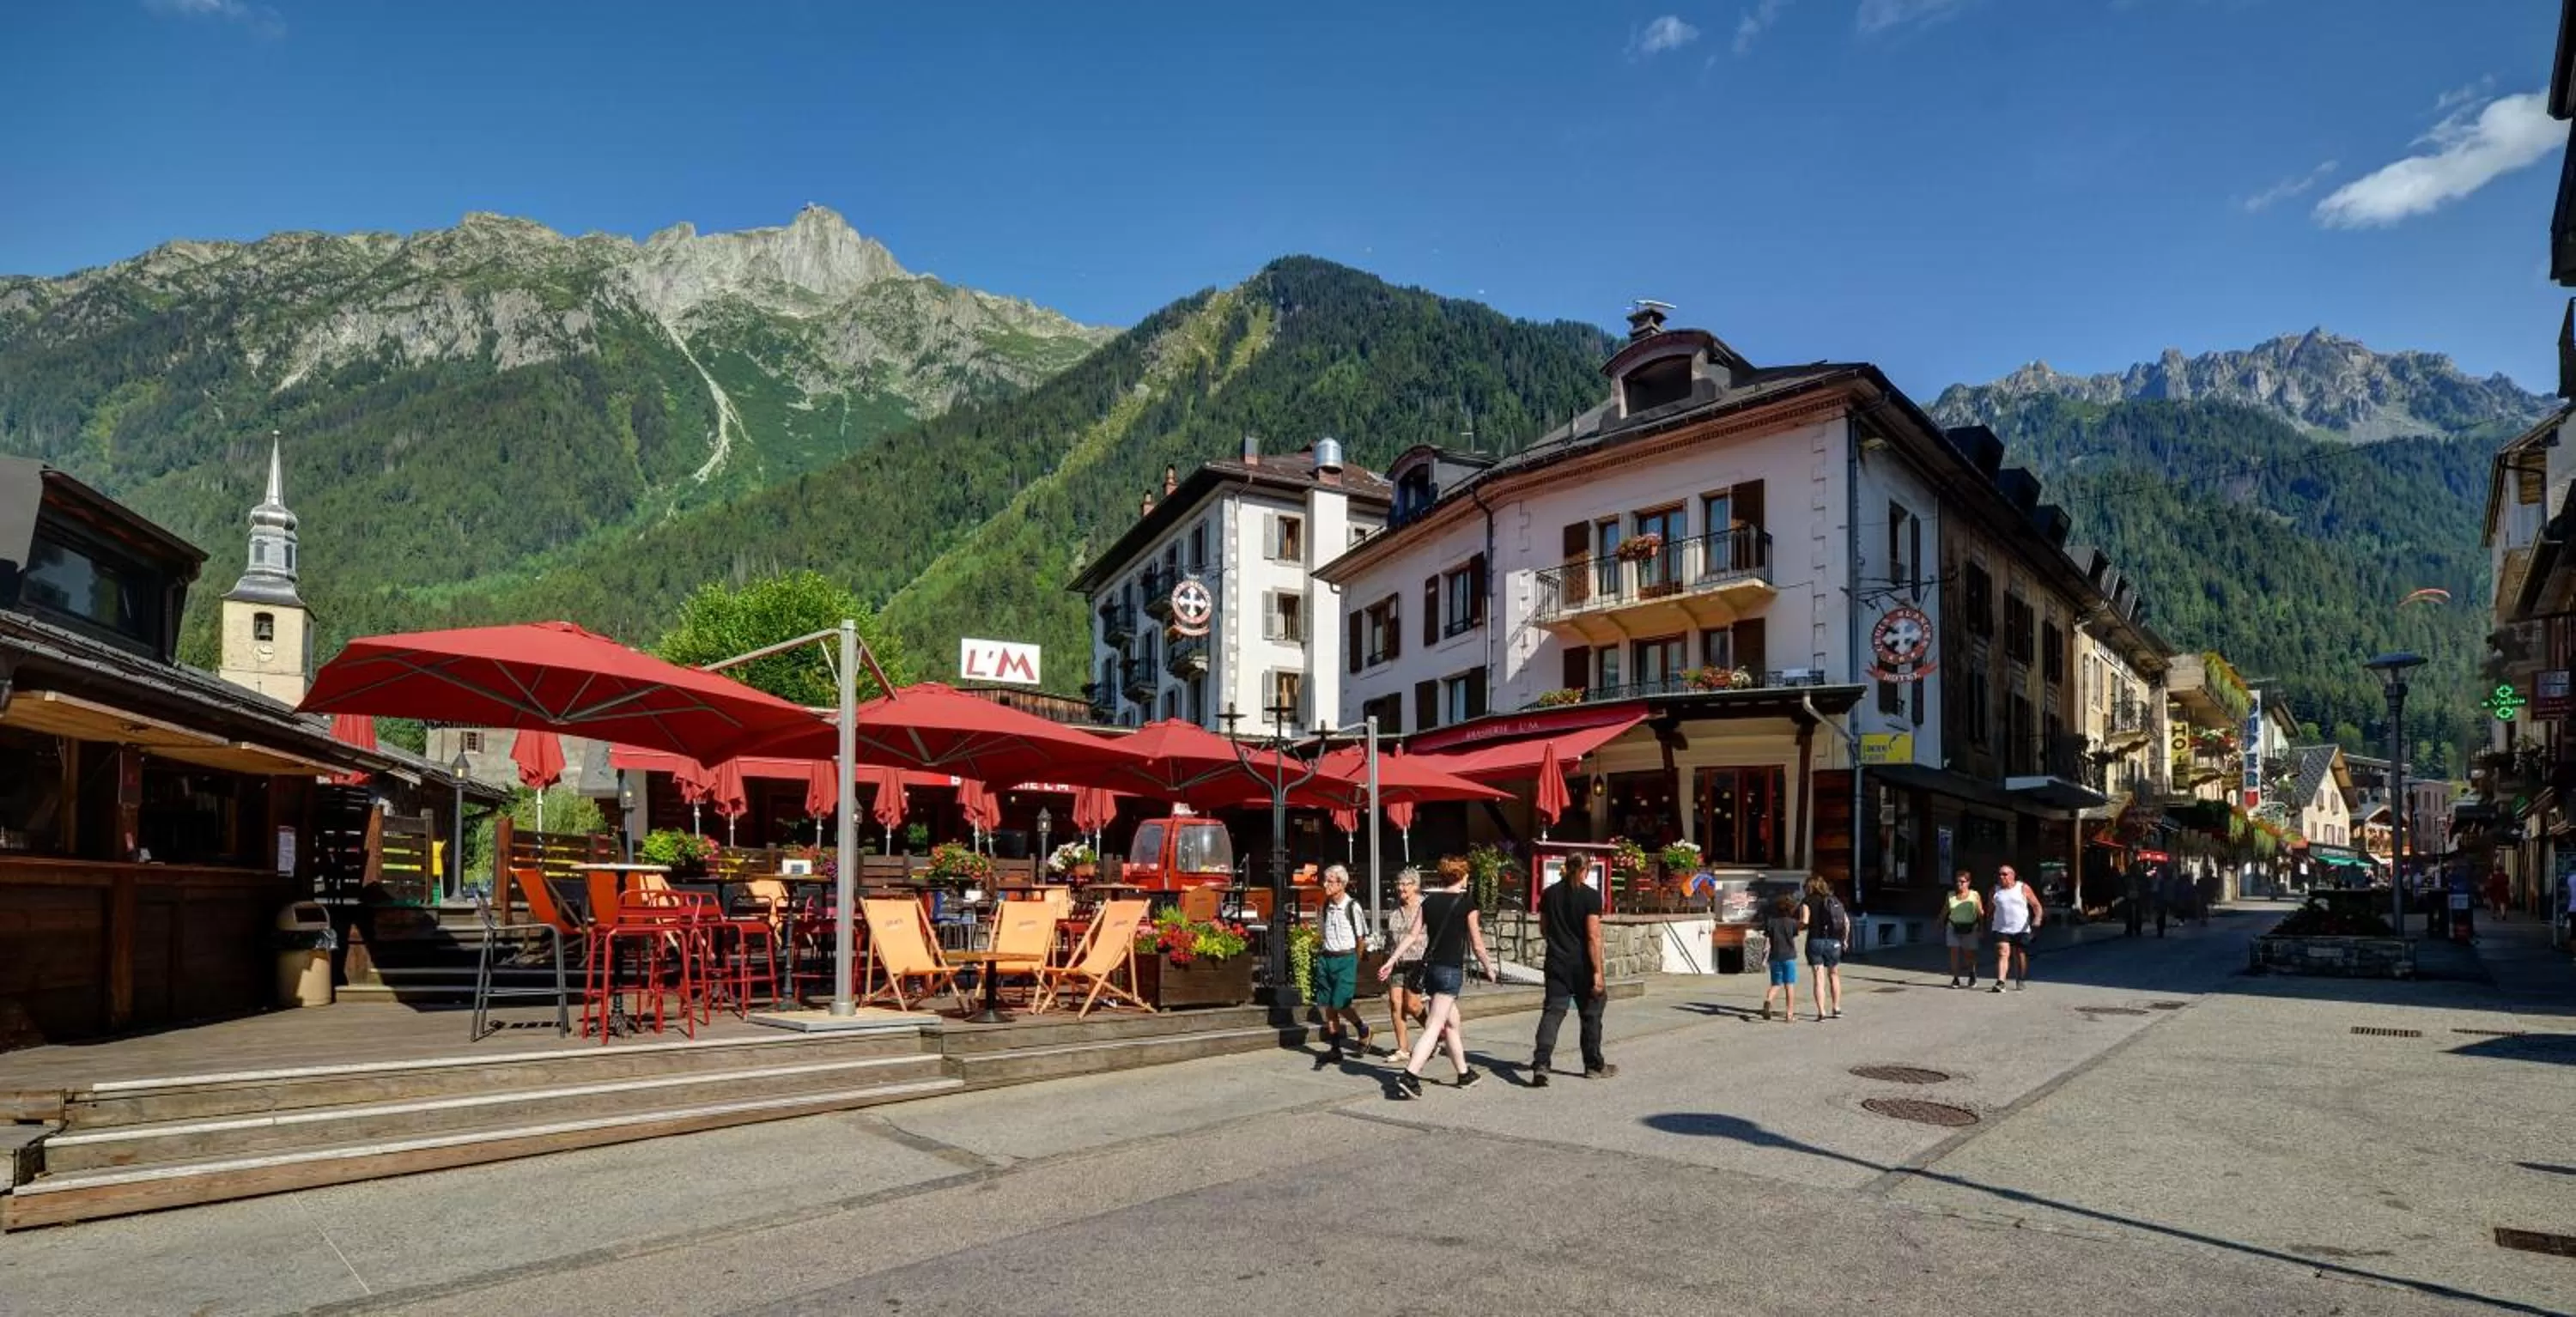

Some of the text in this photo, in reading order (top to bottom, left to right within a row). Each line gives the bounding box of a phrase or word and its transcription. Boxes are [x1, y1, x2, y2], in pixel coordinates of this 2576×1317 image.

[966, 647, 1036, 680] L'M
[1466, 725, 1507, 740] BRASSERIE
[1043, 782, 1069, 792] LM
